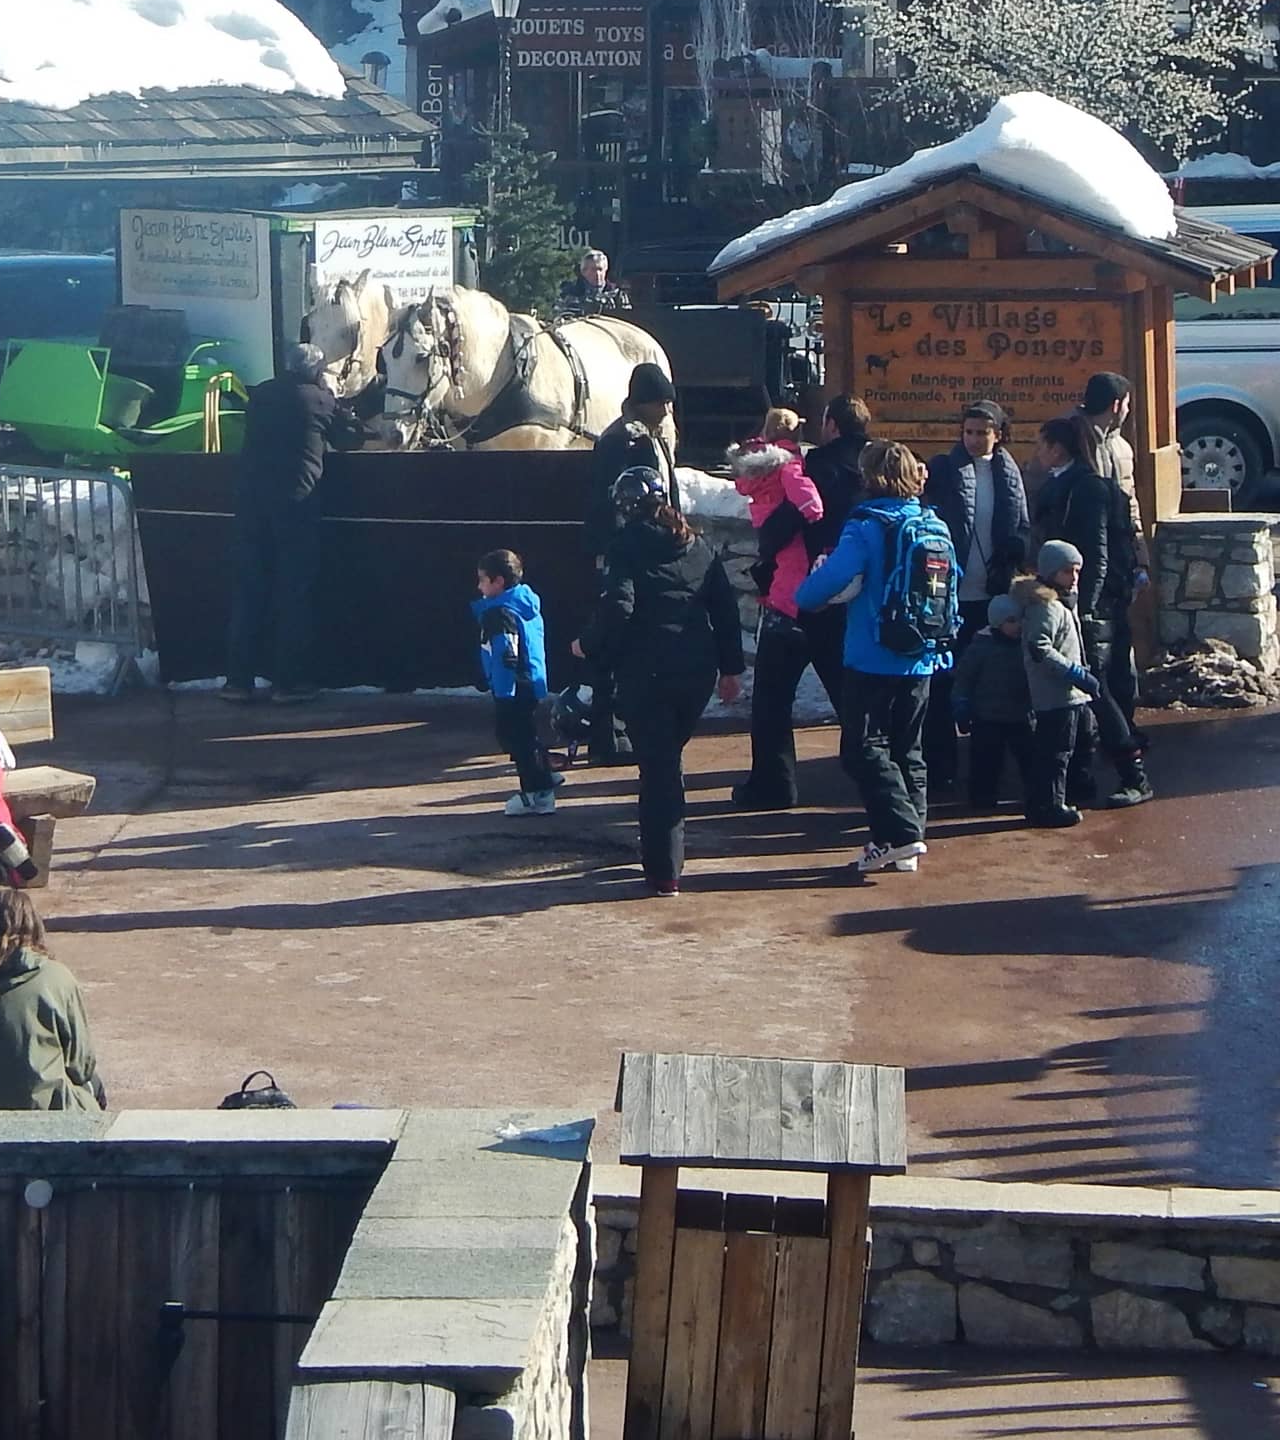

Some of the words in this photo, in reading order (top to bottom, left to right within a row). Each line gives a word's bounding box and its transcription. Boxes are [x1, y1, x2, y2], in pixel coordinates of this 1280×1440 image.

[512, 18, 585, 36] JOUETS
[594, 26, 645, 43] TOYS
[517, 50, 642, 67] DECORATION
[320, 230, 361, 263] Jean
[357, 224, 403, 259] Blanc
[399, 224, 449, 258] Sports
[868, 304, 912, 332] Le
[933, 303, 1058, 334] Village
[916, 332, 967, 357] des
[987, 332, 1104, 361] Poneys
[972, 376, 1003, 389] pour
[1012, 373, 1065, 387] enfants
